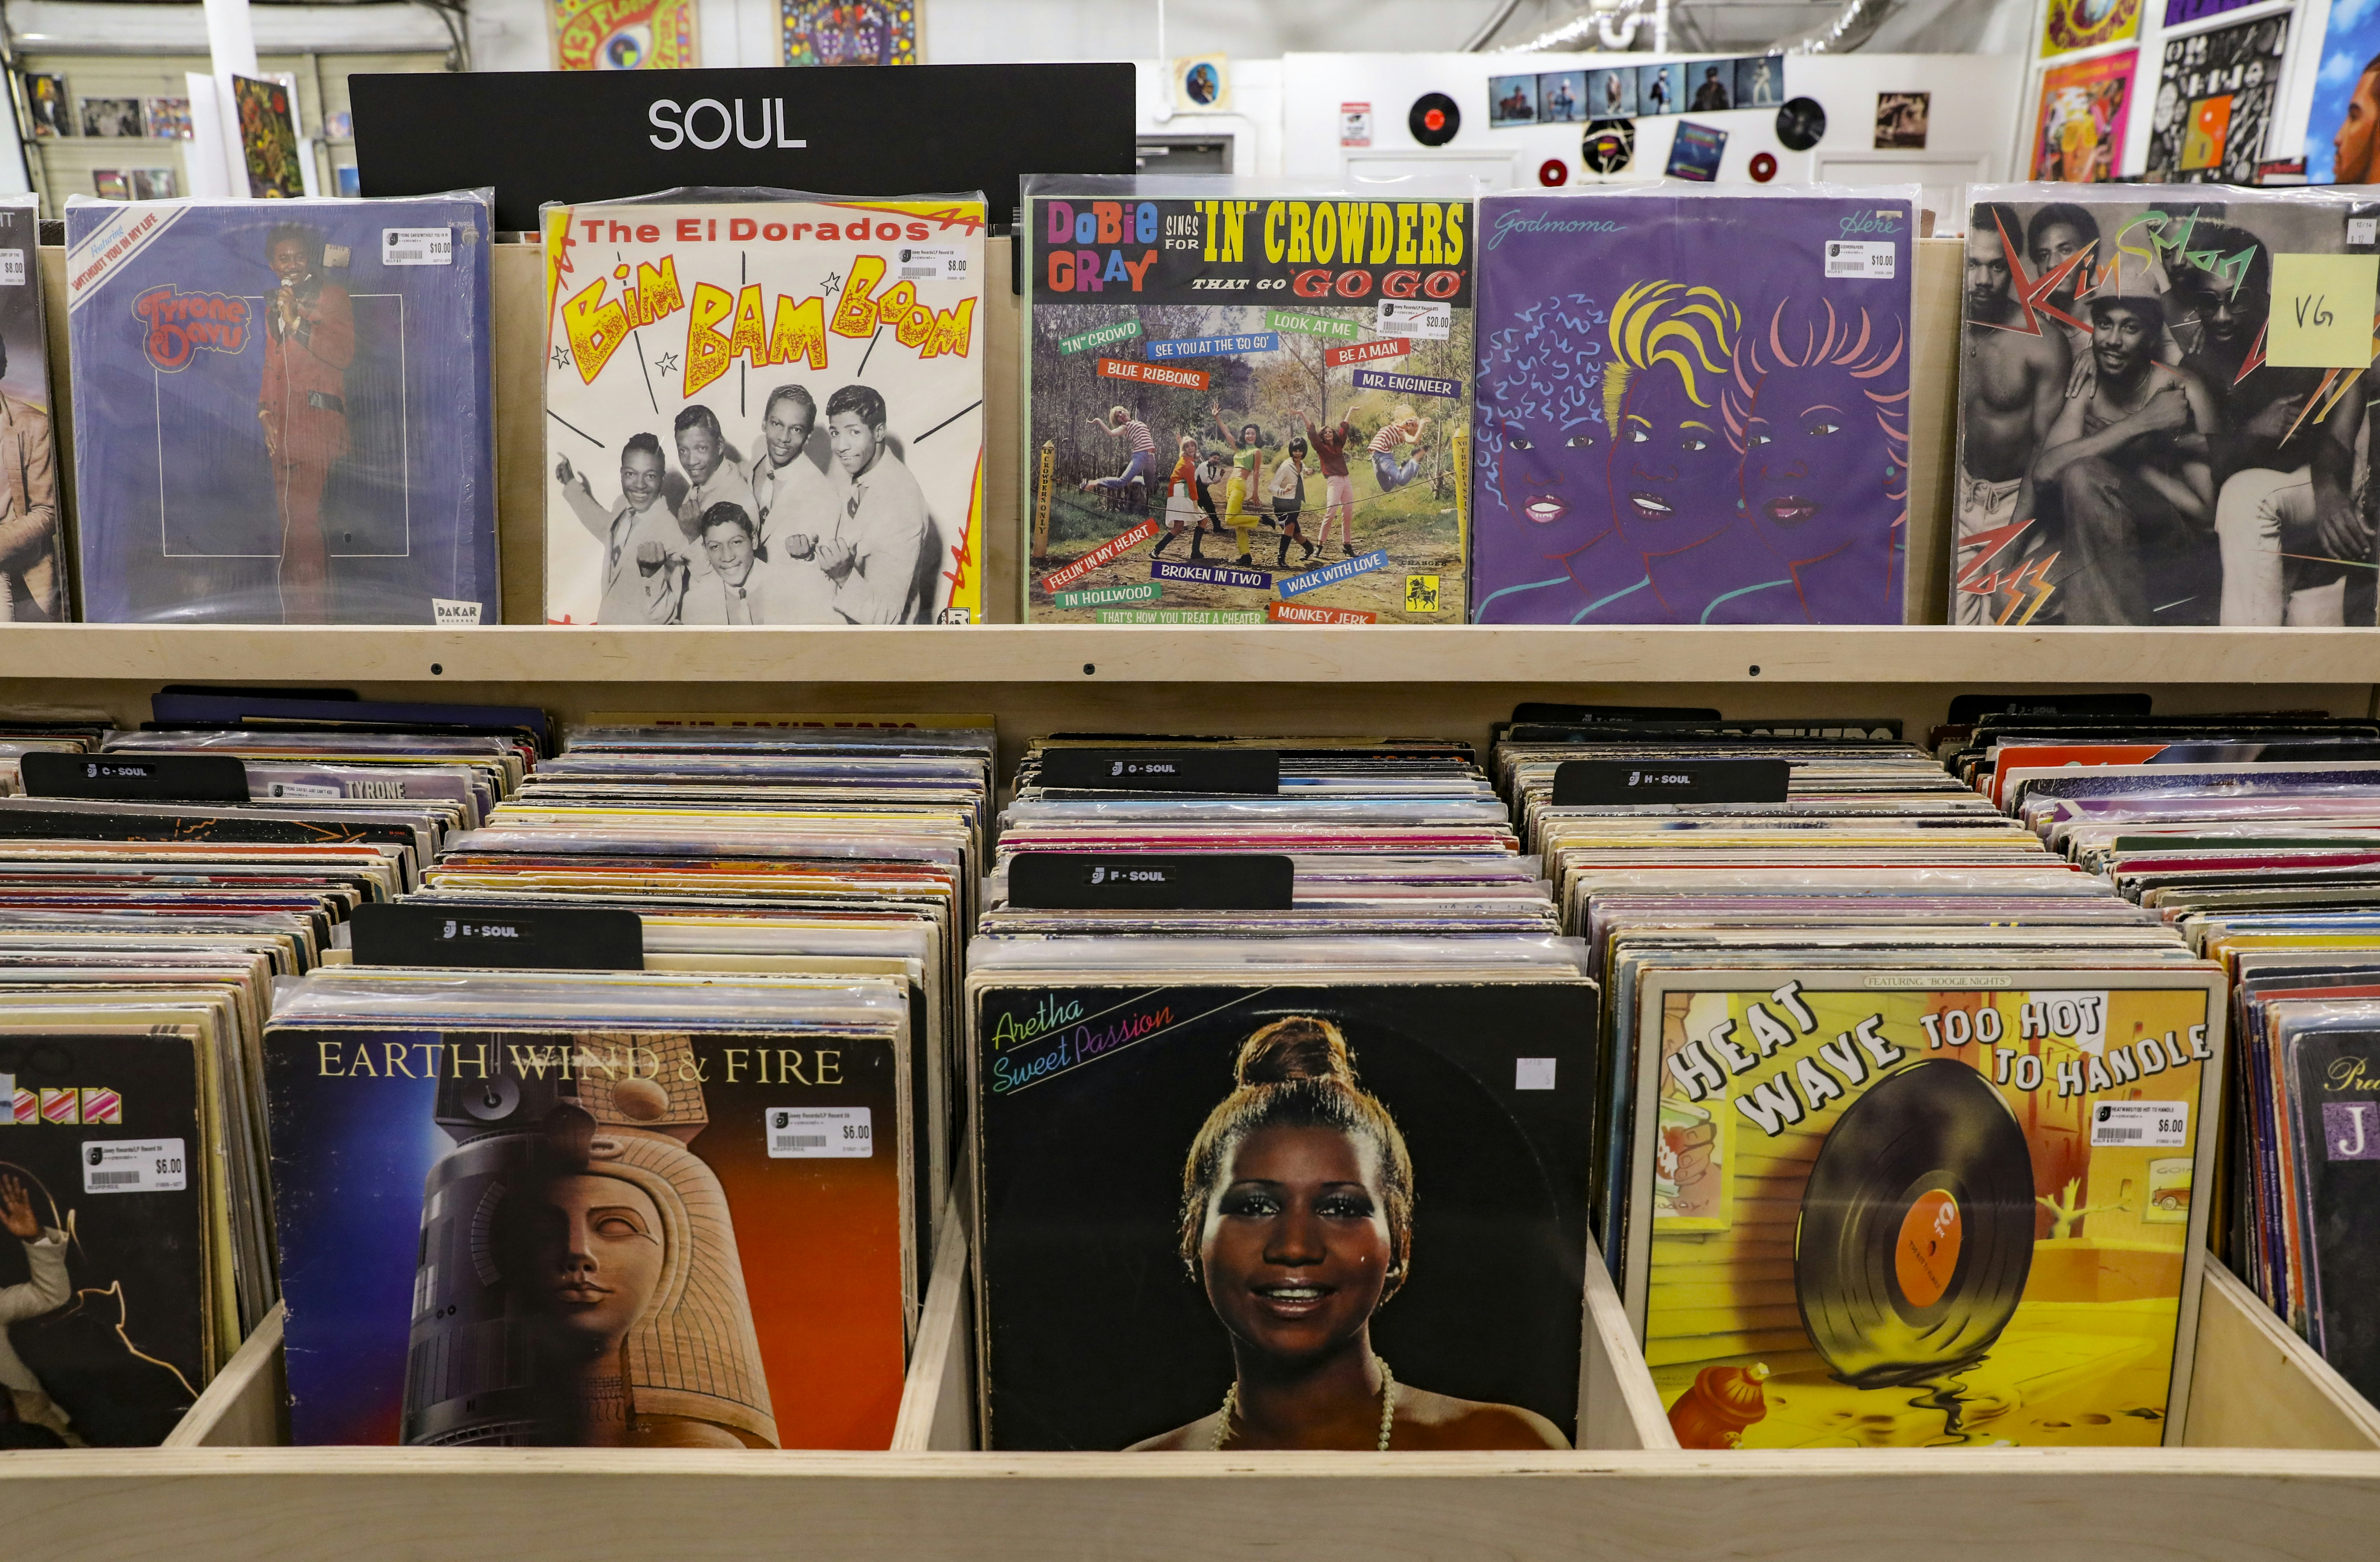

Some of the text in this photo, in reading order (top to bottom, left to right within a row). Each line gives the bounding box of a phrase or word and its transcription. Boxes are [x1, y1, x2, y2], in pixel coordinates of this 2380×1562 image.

[649, 98, 807, 150] SOUL
[581, 218, 931, 243] The El Dorados
[1166, 215, 1199, 236] SINGS
[1265, 201, 1464, 265] CROWDERS
[1488, 210, 1628, 250] Godmoma
[1839, 209, 1904, 239] Here
[91, 225, 124, 258] Featuring
[430, 243, 450, 254] $10.00
[1165, 239, 1199, 250] FOR
[71, 213, 158, 291] WITHOUT YOU IN MY LIFE
[1872, 255, 1893, 266] $10.00
[5, 263, 22, 273] $8.00
[948, 260, 966, 271] $8.00
[1048, 250, 1157, 292] GRAY
[1192, 278, 1286, 290] THAT GO
[138, 290, 245, 331] Tyrone
[1275, 316, 1352, 335] LOOK AT ME
[1426, 316, 1449, 328] $20.00
[683, 282, 828, 399] BAM
[1088, 322, 1137, 346] CROWD
[1155, 343, 1174, 357] SEE
[1175, 342, 1198, 356] YOU
[1199, 340, 1217, 354] AT
[1219, 339, 1235, 352] THE
[1339, 341, 1398, 362] BE A MAN
[1107, 361, 1201, 387] BLUE RIBBONS
[1363, 375, 1452, 395] MR. ENGINEER
[1041, 456, 1049, 503] CROWDERS
[1038, 505, 1047, 534] ONLY
[1049, 557, 1083, 589] FEELIN'
[1096, 541, 1114, 561] MY
[1114, 525, 1149, 552] HEART
[1161, 565, 1261, 586] BROKEN IN TWO
[1287, 554, 1381, 594] WALK WITH LOVE
[1065, 586, 1152, 606] IN HOLLWOOD
[438, 607, 477, 616] DAKAR
[1103, 612, 1261, 624] THAT'S HOW YOU TREAT A CHEATER
[1277, 606, 1369, 624] MONKEY JERK
[102, 767, 111, 775] C
[118, 767, 147, 776] SOUL
[1128, 764, 1175, 773] G SOUL
[1661, 775, 1690, 783] SOUL
[345, 780, 405, 799] TYRONE
[1110, 871, 1165, 881] F SOUL
[463, 925, 519, 937] E SOUL
[1868, 977, 1925, 986] FEATURING:
[992, 997, 1084, 1051] Aretha
[1920, 995, 2101, 1051] TOO HOT
[993, 1004, 1174, 1093] Sweet Passion
[317, 1042, 844, 1086] EARTH WIND & FIRE
[1666, 980, 1906, 1138] HEAT WAVE
[1995, 1023, 2214, 1100] TO HANDLE
[843, 1125, 869, 1139] $6.00
[2159, 1119, 2183, 1132] $6.00
[156, 1158, 181, 1174] $6.00
[1934, 1218, 1946, 1238] Epic
